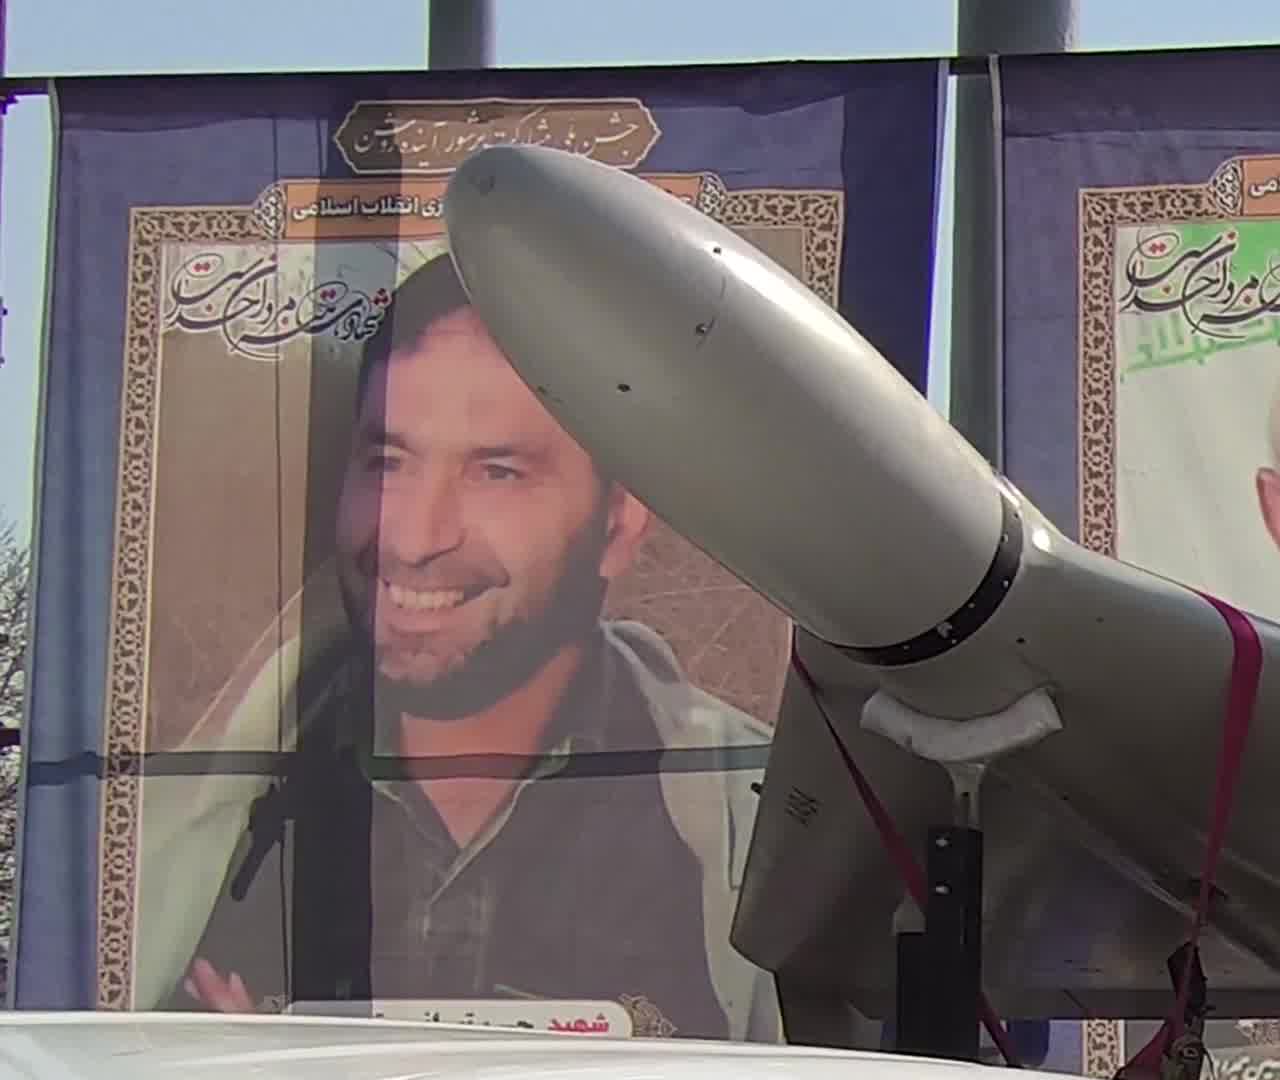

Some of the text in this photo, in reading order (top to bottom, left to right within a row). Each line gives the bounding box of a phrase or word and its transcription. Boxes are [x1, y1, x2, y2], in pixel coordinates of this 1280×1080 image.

[353, 111, 417, 152] روشن
[292, 196, 358, 220] اسلامی
[361, 195, 419, 221] انقلاب
